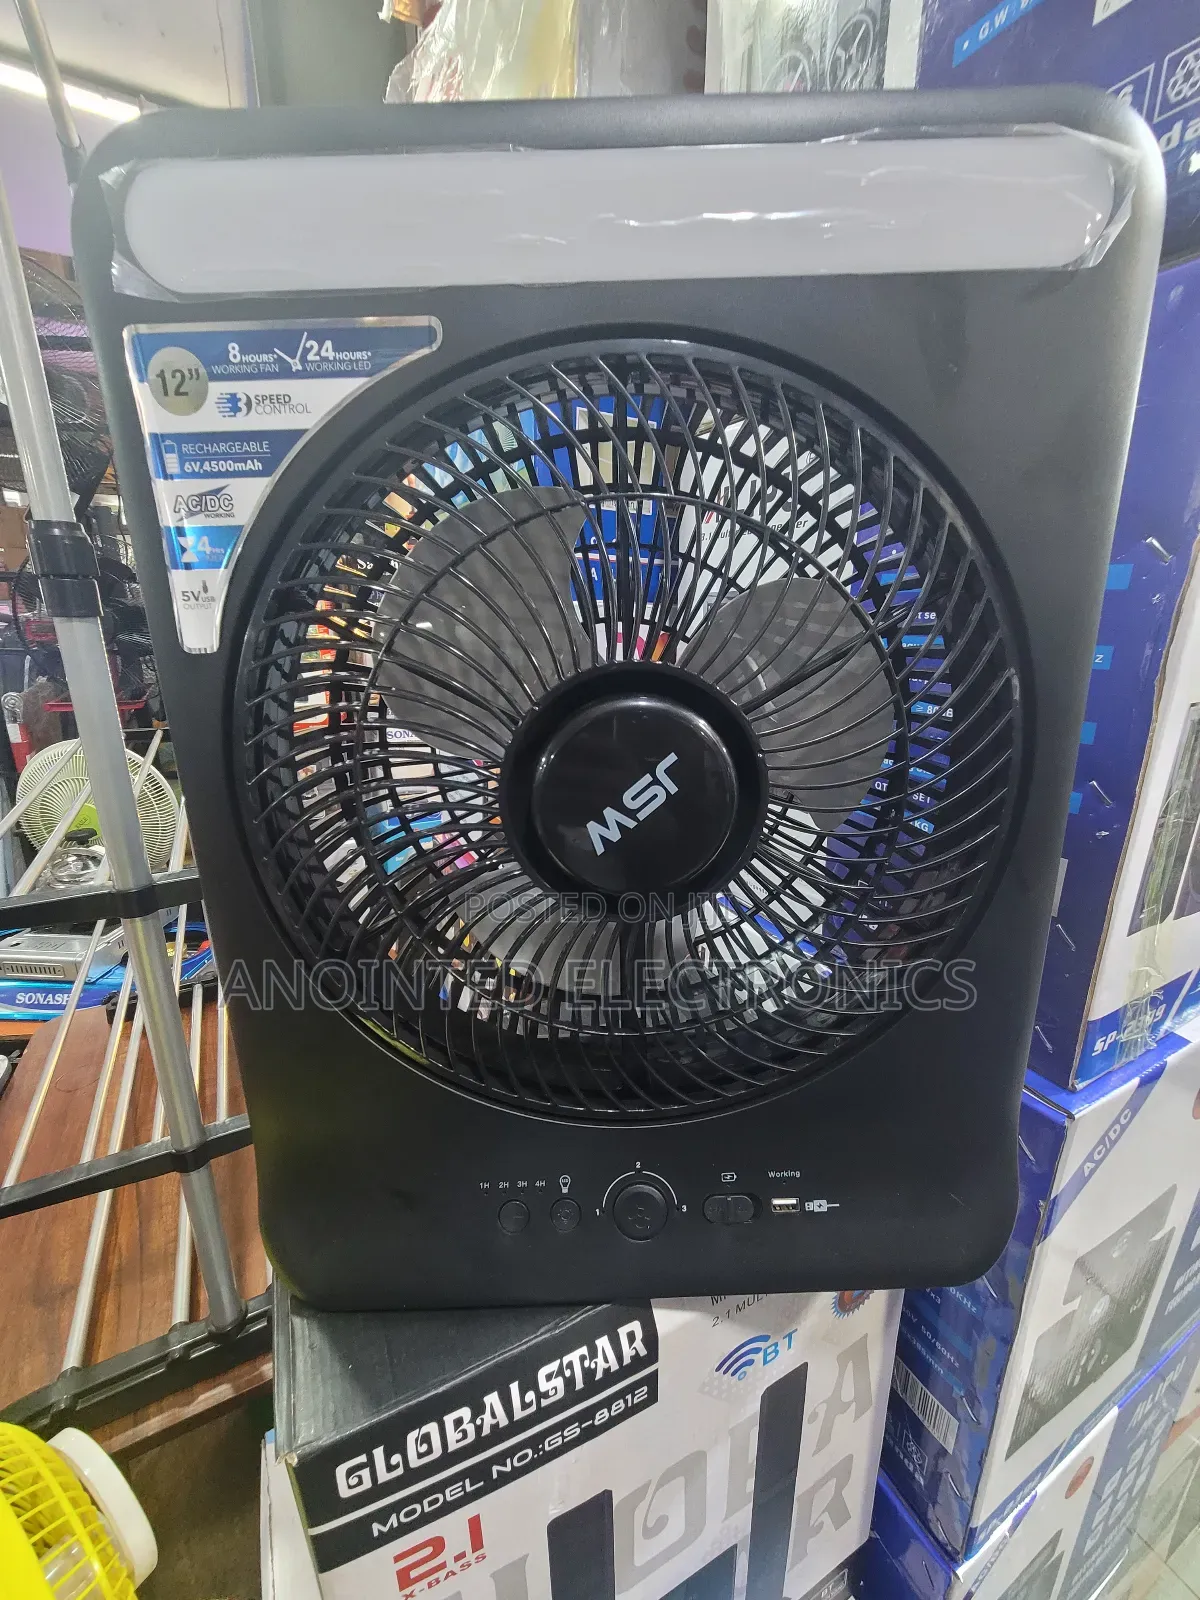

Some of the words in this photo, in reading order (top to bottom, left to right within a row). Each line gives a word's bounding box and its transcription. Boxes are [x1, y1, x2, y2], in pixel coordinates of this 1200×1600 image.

[227, 341, 241, 364] 8
[305, 340, 335, 362] 24
[211, 363, 258, 374] WORKING
[260, 363, 279, 373] FAN
[305, 361, 352, 371] WORKING
[354, 360, 372, 371] LED
[254, 393, 292, 405] SPEED
[254, 403, 312, 416] CONTROL
[181, 441, 270, 455] RECHARGEABLE
[184, 458, 263, 474] 6V,4500mAh
[173, 493, 234, 514] AC/DC
[197, 535, 210, 555] 4
[181, 590, 201, 602] 5V
[1083, 1108, 1132, 1177] AC/DC
[479, 1181, 490, 1190] 1H
[498, 1181, 510, 1189] 2H
[516, 1180, 528, 1188] 3H
[534, 1179, 546, 1187] 4H
[768, 1170, 801, 1179] Working
[762, 1327, 799, 1368] BT
[334, 1319, 649, 1500] GLOBALSTAR
[370, 1477, 484, 1538] MODEL
[392, 1512, 485, 1593] 2.1
[401, 1552, 487, 1600] X-BASS
